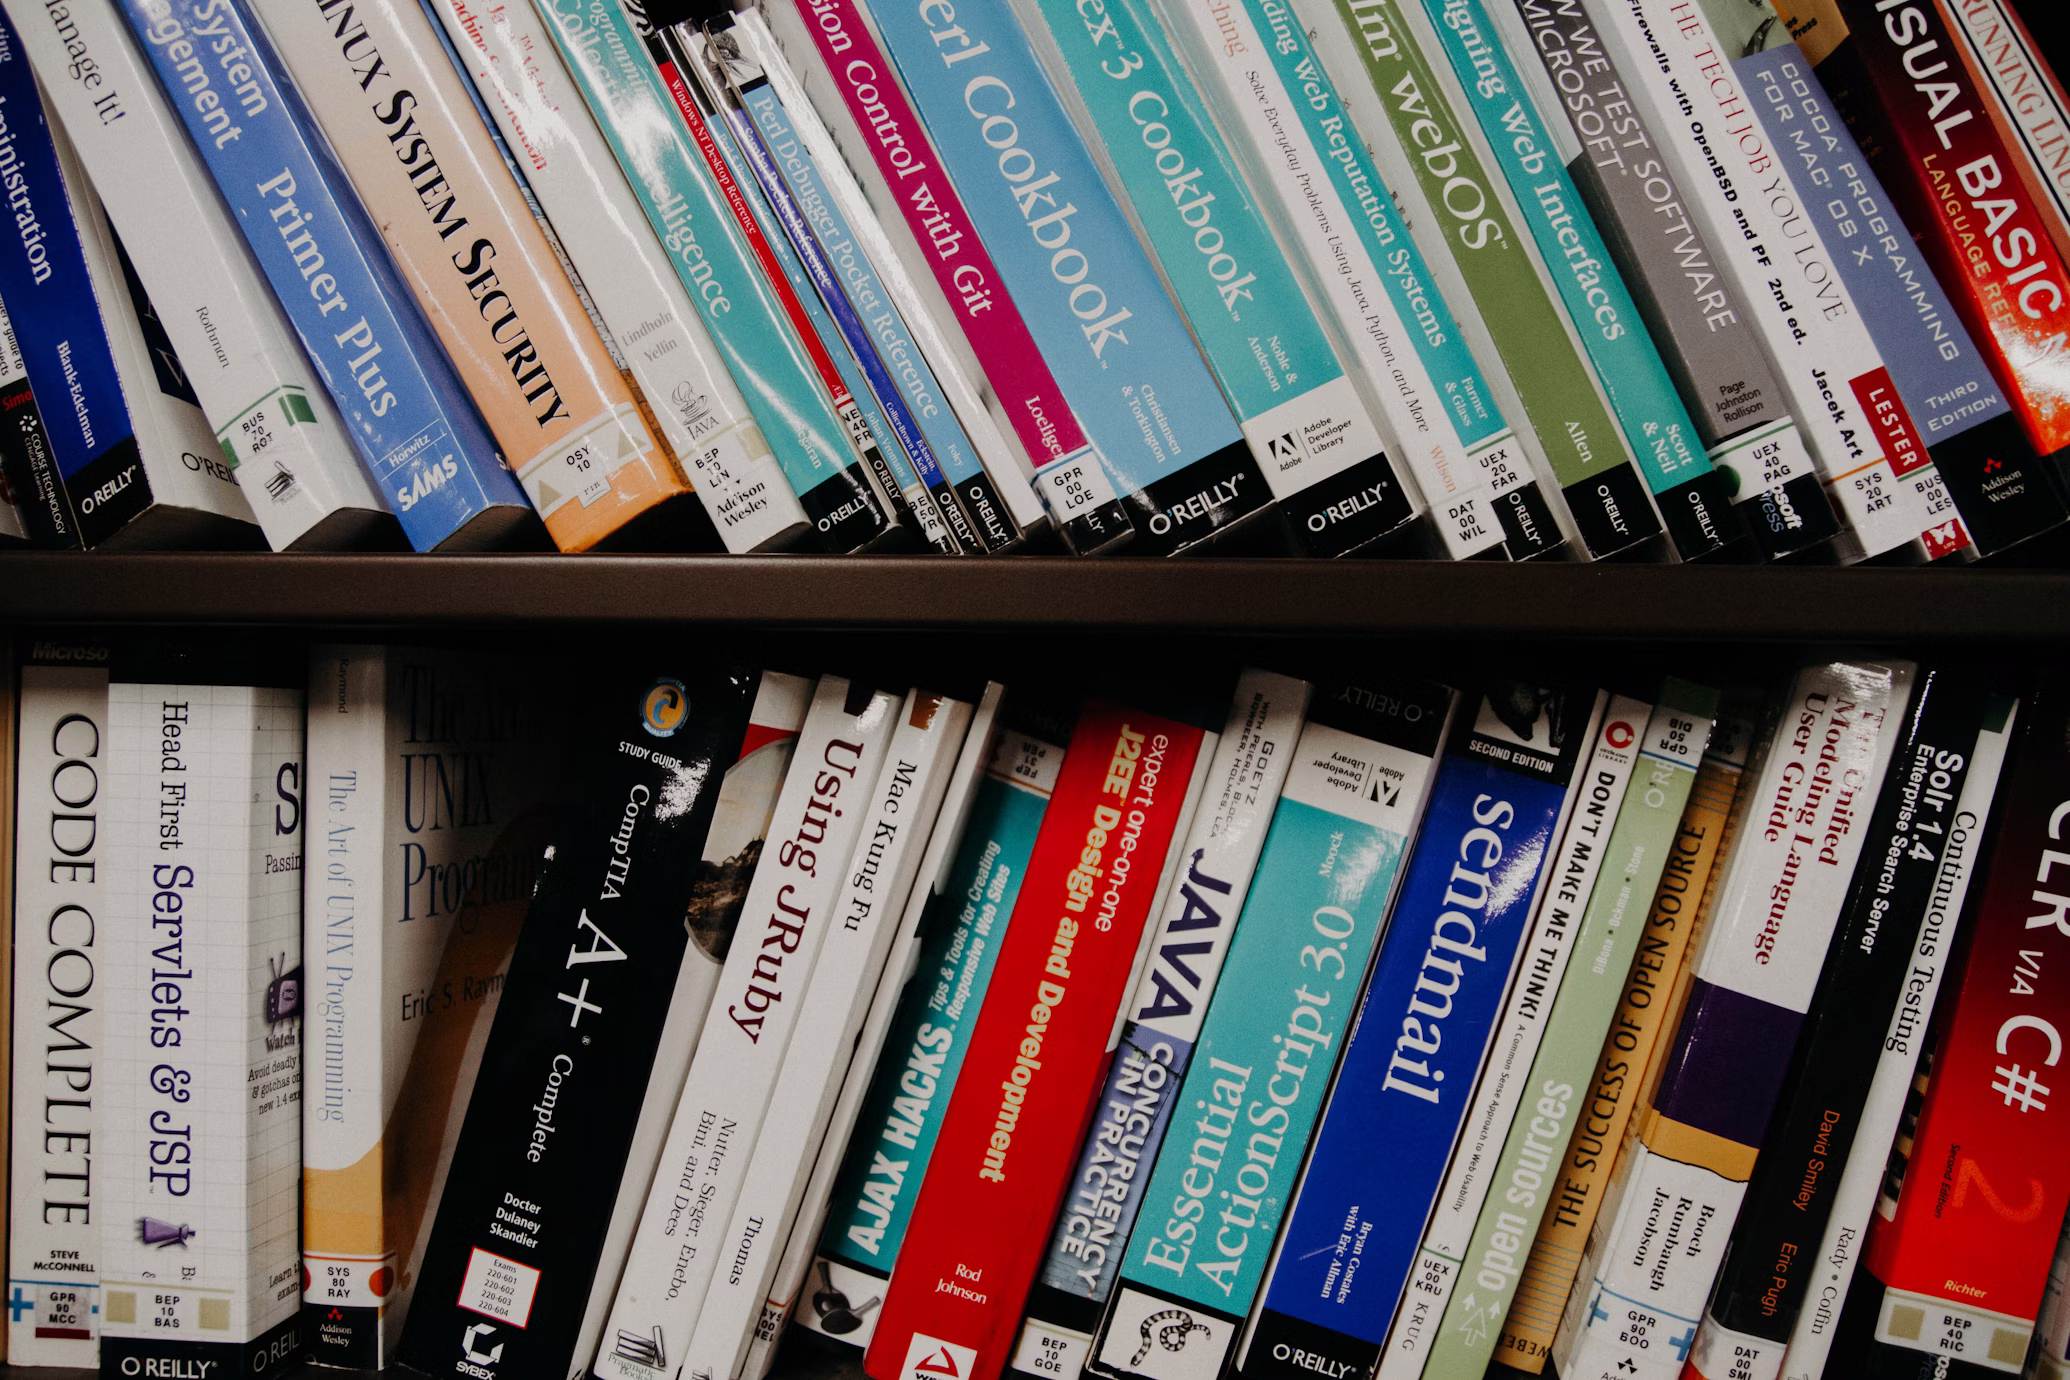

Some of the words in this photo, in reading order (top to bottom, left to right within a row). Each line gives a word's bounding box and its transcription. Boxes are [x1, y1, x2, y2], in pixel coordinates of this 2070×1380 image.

[671, 78, 699, 128] Windows
[695, 118, 709, 145] NT
[704, 142, 730, 184] Desktop
[725, 180, 757, 236] Reference
[846, 60, 926, 180] Control
[910, 182, 961, 261] with
[953, 264, 992, 318] Git
[1101, 51, 1145, 81] 3
[1128, 90, 1258, 313] Cookbook
[1390, 70, 1503, 250] webOS
[1570, 25, 1611, 77] WE
[1597, 82, 1648, 154] TEST
[1633, 160, 1738, 332] SOFTWARE
[1694, 48, 1746, 120] TECH
[1726, 118, 1772, 174] JOB
[1762, 177, 1808, 239] YOU
[1794, 244, 1848, 322] LOVE
[964, 75, 1133, 361] Cookbook
[1293, 55, 1328, 113] Web
[1320, 114, 1396, 248] Reputation
[1388, 248, 1447, 349] Systems
[1500, 100, 1547, 174] Web
[1534, 178, 1625, 342] Interfaces
[1668, 77, 1693, 117] with
[1690, 122, 1738, 202] OpenBSD
[1732, 207, 1759, 243] and
[1751, 243, 1773, 267] PF
[1767, 278, 1793, 313] 2nd
[1787, 317, 1808, 346] ed.
[1781, 62, 1843, 153] COCOA
[1838, 163, 1959, 362] PROGRAMMING
[1956, 154, 2062, 320] BASIC
[372, 90, 469, 243] SYSTEM
[452, 239, 570, 430] SECURITY
[752, 95, 781, 142] Perl
[776, 140, 841, 240] Debugger
[831, 231, 879, 313] Pocket
[872, 313, 939, 419] Reference
[1245, 69, 1269, 105] Solve
[1264, 106, 1302, 171] Everyday
[1298, 172, 1332, 234] Problems
[1328, 234, 1352, 276] Using
[1346, 275, 1371, 315] Java,
[1365, 315, 1395, 368] Python,
[1391, 368, 1412, 398] and
[1405, 397, 1430, 433] More
[257, 167, 347, 317] Primer
[334, 316, 397, 418] Plus
[196, 306, 230, 368] Rothman
[56, 340, 95, 449] Blank-Edelman
[1303, 416, 1333, 435] Adobe
[1810, 368, 1847, 425] Jacek
[1839, 428, 1864, 460] Art
[1869, 388, 1918, 467] LESTER
[1307, 418, 1353, 445] Developer
[1312, 435, 1345, 456] Library
[1564, 419, 1594, 464] Allen
[397, 454, 458, 512] SAMS
[1429, 445, 1457, 495] Wilson
[1449, 500, 1475, 519] DAT
[1459, 525, 1487, 542] WIL
[161, 701, 188, 773] Head
[618, 741, 650, 760] STUDY
[651, 751, 682, 770] GUIDE
[1469, 739, 1510, 765] SECOND
[1512, 750, 1554, 774] EDITION
[1791, 692, 1829, 755] User
[50, 713, 100, 884] CODE
[329, 770, 357, 812] The
[884, 758, 918, 814] Mac
[1102, 724, 1145, 802] J2EE
[1139, 733, 1169, 807] expert
[1795, 698, 1856, 828] Modeling
[1895, 743, 1936, 833] Enterprise
[1923, 750, 1964, 812] Solr
[159, 781, 187, 851] First
[779, 738, 865, 877] Using
[1590, 771, 1617, 838] DON'T
[1764, 761, 1805, 843] Guide
[327, 862, 354, 886] of
[328, 821, 355, 858] Art
[852, 818, 898, 894] Kung
[1066, 804, 1123, 913] Design
[1095, 811, 1147, 933] one-on-one
[1558, 841, 1593, 904] MAKE
[1877, 835, 1909, 893] Search
[1908, 821, 1944, 862] 1.4
[844, 895, 872, 932] Fu
[1657, 825, 1706, 932] SOURCE
[1754, 832, 1815, 966] Language
[1919, 810, 1977, 957] Continuous
[151, 864, 194, 1048] Servlets
[326, 895, 355, 958] UNIX
[1045, 916, 1079, 979] and
[1137, 848, 1233, 1021] JAVA
[1381, 793, 1514, 1104] sendmail
[1546, 908, 1570, 942] ME
[1860, 898, 1890, 955] Server
[728, 884, 811, 1045] JRuby
[1518, 946, 1558, 1021] THINK!
[1627, 936, 1669, 1009] OPEN
[2009, 950, 2044, 995] VIA
[316, 966, 353, 1124] Programming
[1614, 1013, 1644, 1051] OF
[1885, 966, 1936, 1056] Testing
[44, 904, 95, 1225] COMPLETE
[150, 1064, 191, 1103] &
[979, 980, 1066, 1183] Development
[1116, 1056, 1146, 1095] IN
[1991, 1014, 2063, 1114] C#
[526, 1053, 574, 1164] Complete
[691, 1110, 717, 1149] Bini,
[1196, 984, 1333, 1297] ActionScript
[1300, 905, 1354, 980] 3.0
[1573, 1059, 1630, 1174] SUCCESS
[1814, 1109, 1841, 1156] David
[149, 1110, 191, 1197] JSP
[679, 1155, 698, 1191] and
[705, 1118, 737, 1176] Nutter,
[848, 1150, 910, 1256] AJAX
[882, 1022, 953, 1150] HACKS
[1077, 1042, 1173, 1290] CONCURRENCY
[1144, 1056, 1253, 1277] Essential
[504, 1192, 542, 1214] Docter
[664, 1194, 690, 1237] Dees
[686, 1182, 716, 1237] Sieger,
[1060, 1101, 1124, 1258] PRACTICE
[1477, 1207, 1528, 1291] open
[1506, 1079, 1573, 1208] sources
[1552, 1178, 1590, 1229] THE
[1793, 1159, 1824, 1212] Smiley
[50, 1250, 80, 1260] STEVE
[489, 1222, 539, 1249] Skandier
[495, 1206, 541, 1234] Dulaney
[729, 1215, 764, 1287] Thomas
[1633, 1186, 1670, 1268] Jacobson
[1649, 1196, 1694, 1292] Rumbaugh
[1686, 1203, 1716, 1258] Booch
[478, 1299, 509, 1317] 220-604
[481, 1289, 512, 1306] 220-603
[484, 1278, 515, 1295] 220-602
[487, 1268, 518, 1285] 220-601
[665, 1244, 697, 1301] Enebo,
[1944, 1280, 1988, 1300] Richter
